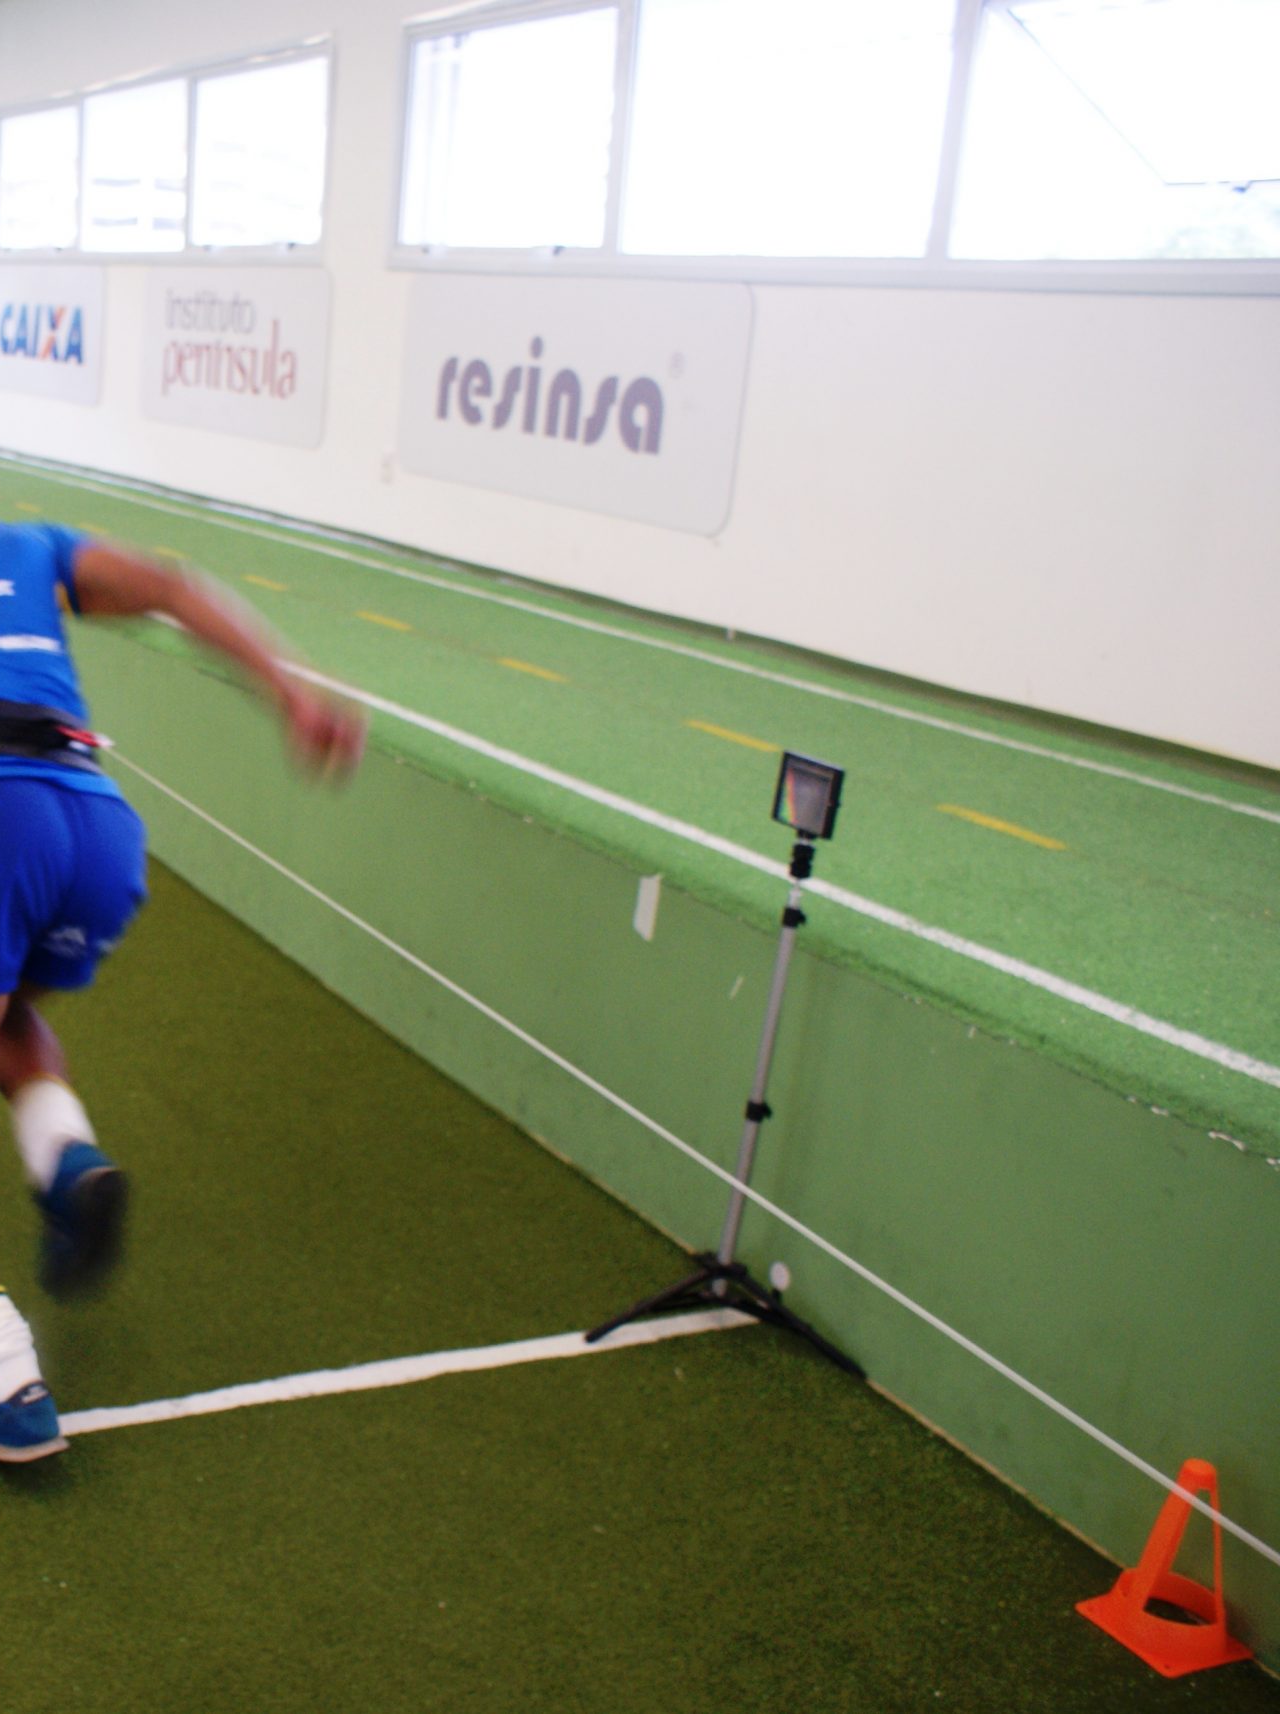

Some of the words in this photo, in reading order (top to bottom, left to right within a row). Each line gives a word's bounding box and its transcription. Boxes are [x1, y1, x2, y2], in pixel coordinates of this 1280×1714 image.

[0, 303, 84, 365] CAIXA
[165, 290, 256, 335] instituto
[161, 318, 298, 399] peninsula
[437, 336, 664, 455] resinsa
